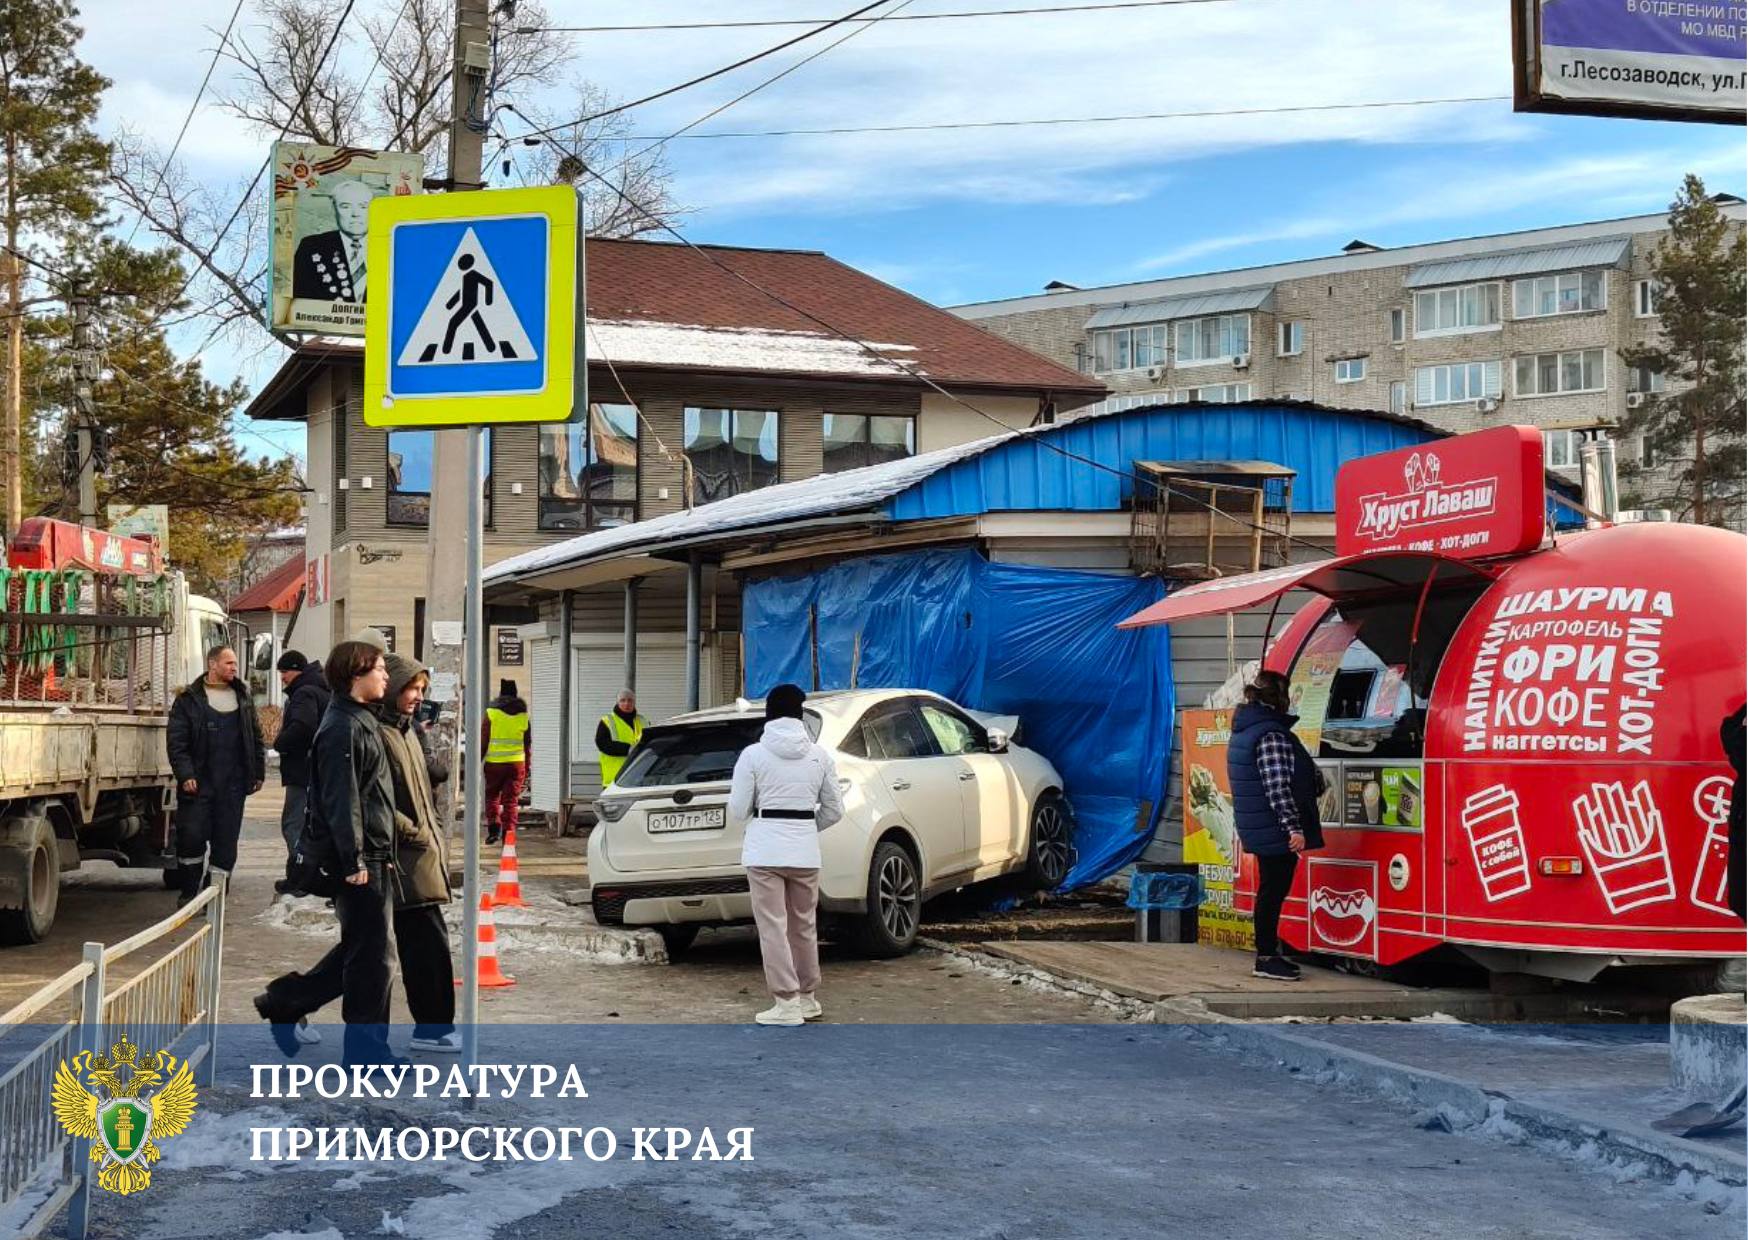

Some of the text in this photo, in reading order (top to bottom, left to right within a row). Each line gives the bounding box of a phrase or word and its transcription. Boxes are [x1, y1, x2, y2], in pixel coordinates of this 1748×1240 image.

[1626, 0, 1637, 13] В
[1639, 1, 1725, 19] ОТДЕЛЕНИИ
[1681, 21, 1704, 36] МО
[1707, 23, 1737, 42] МВД
[1561, 60, 1705, 90] г.Лесозаводск,
[1362, 485, 1493, 532] Хруст Лаваш
[1440, 531, 1490, 550] ХОТ-ДОГИ
[1495, 586, 1674, 619] ШАУРМА
[1508, 619, 1624, 642] КАРТОФЕЛЬ
[1502, 643, 1617, 684] ФРИ
[1463, 618, 1512, 752] НАПИТКИ
[1617, 617, 1665, 755] ХОТ-ДОГИ
[1494, 686, 1610, 727] КОФЕ
[1492, 734, 1607, 752] наггетсы
[704, 810, 721, 822] 125
[1481, 846, 1520, 869] с собой
[1482, 837, 1513, 857] КОФЕ
